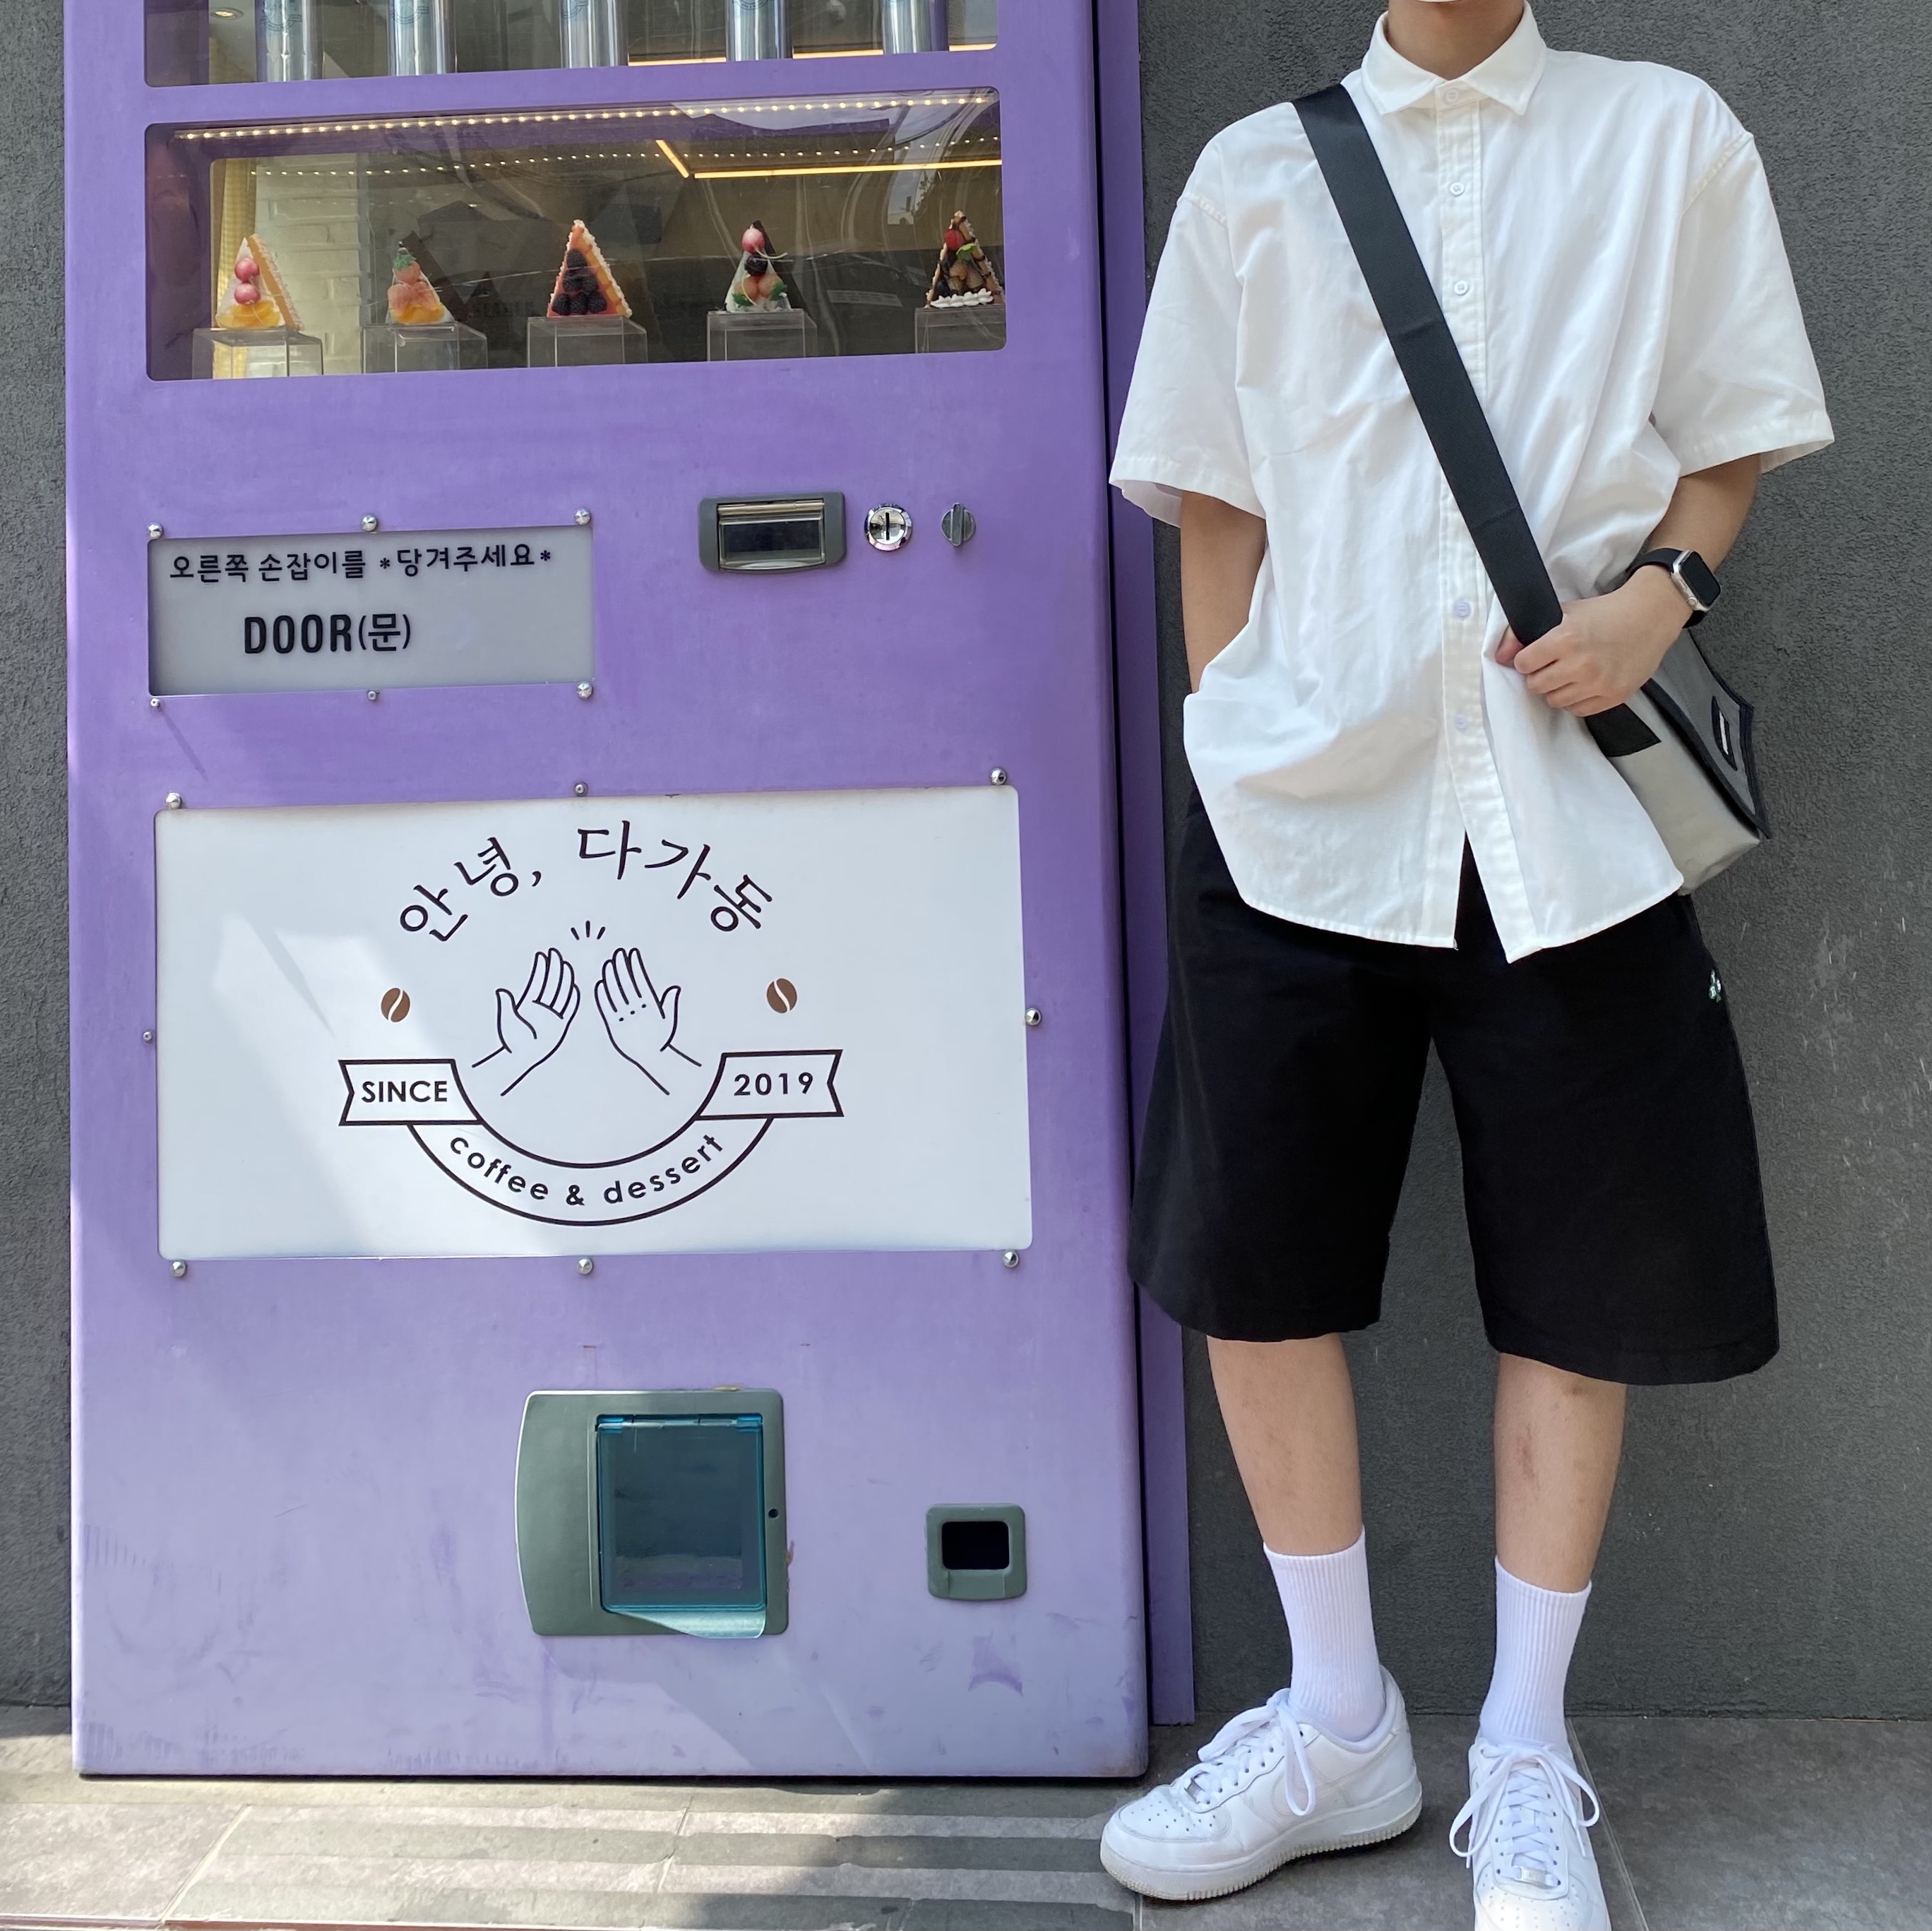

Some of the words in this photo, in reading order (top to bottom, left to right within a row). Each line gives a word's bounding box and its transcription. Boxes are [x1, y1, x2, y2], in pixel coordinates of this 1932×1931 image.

[169, 554, 249, 583] 오른쪽
[258, 550, 366, 582] 손잡이를
[244, 613, 412, 654] DOOR(문)
[400, 837, 542, 942] 안녕,
[577, 820, 773, 932] 다가동
[361, 1080, 448, 1103] SINCE
[733, 1072, 814, 1097] 2019
[450, 1137, 549, 1200] coffee
[566, 1184, 585, 1206] &
[604, 1135, 723, 1204] dessert
